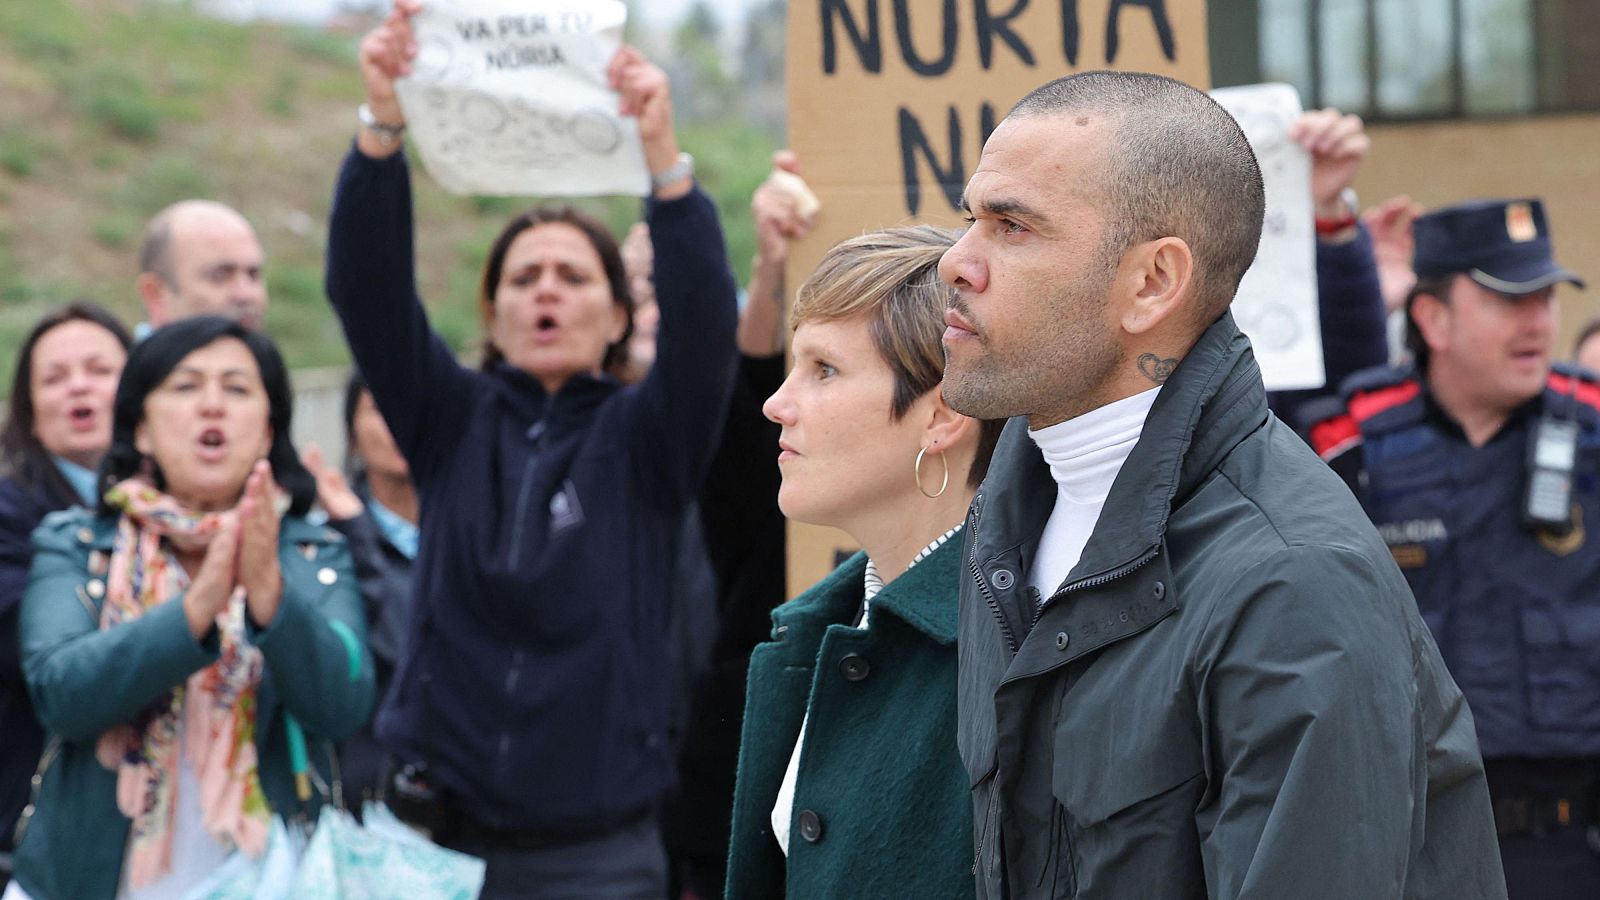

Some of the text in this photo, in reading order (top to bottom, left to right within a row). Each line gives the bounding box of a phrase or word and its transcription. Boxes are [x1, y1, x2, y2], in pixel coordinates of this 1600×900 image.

[454, 10, 593, 42] VA PER TU
